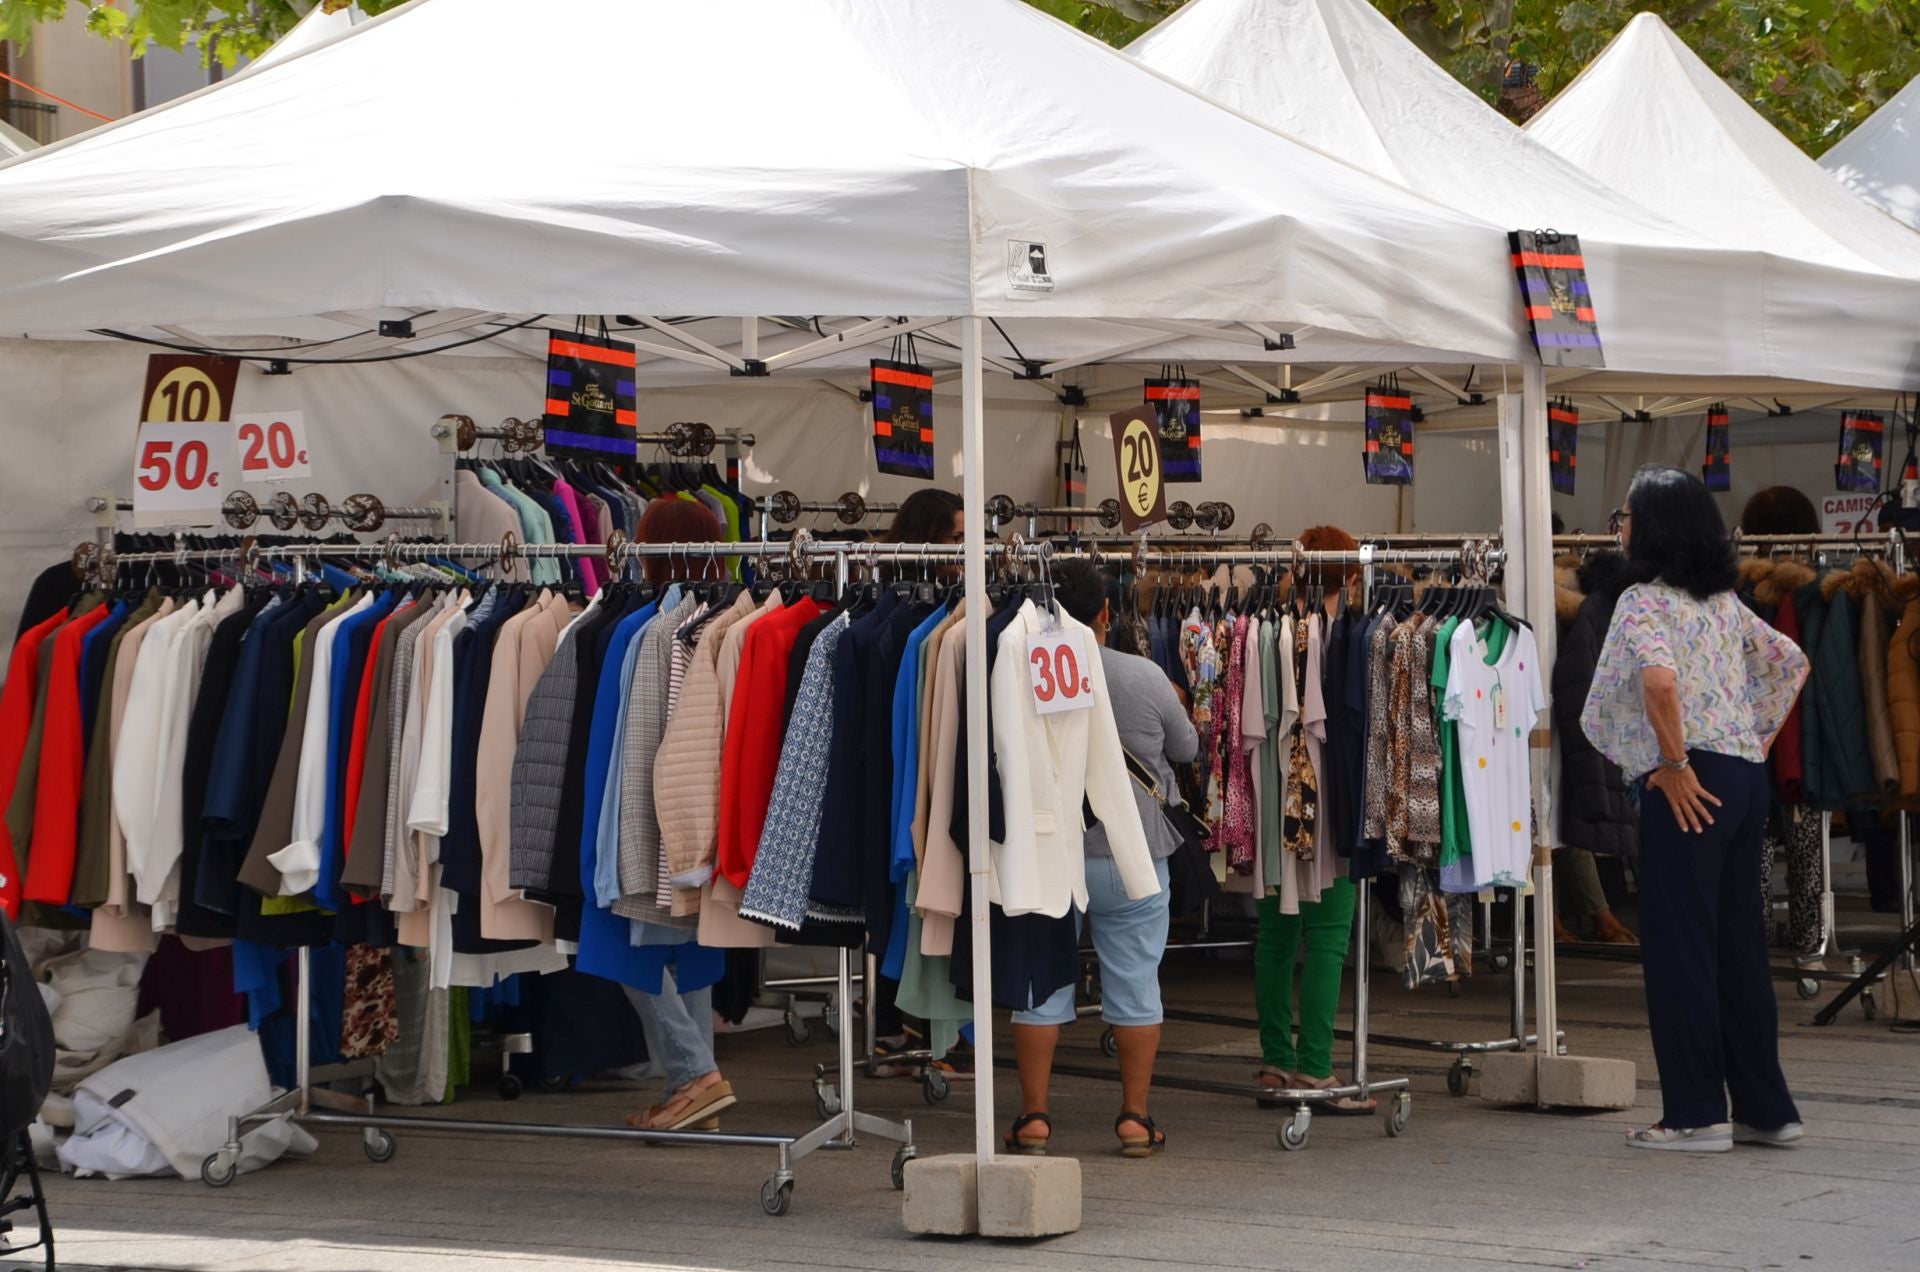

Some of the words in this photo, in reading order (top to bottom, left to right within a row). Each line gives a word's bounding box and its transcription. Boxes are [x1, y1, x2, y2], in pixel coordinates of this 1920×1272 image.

[161, 380, 210, 422] 10
[138, 440, 219, 491] 50€
[238, 421, 309, 471] 20€
[1124, 431, 1153, 483] 20
[1137, 482, 1150, 511] €
[1030, 644, 1091, 702] 30€
